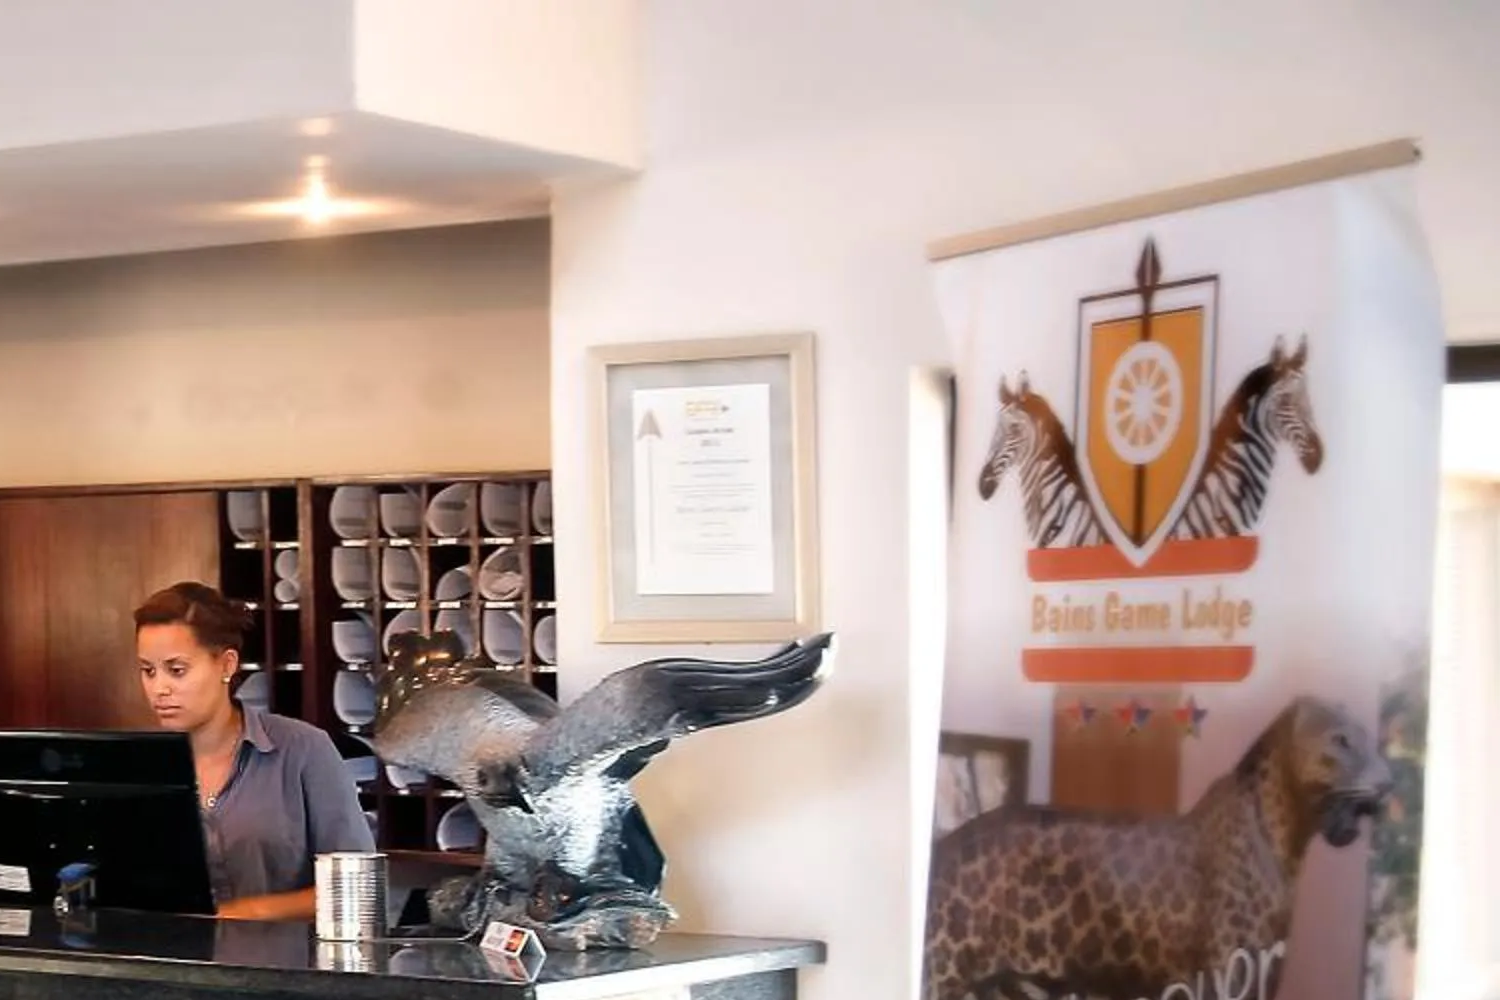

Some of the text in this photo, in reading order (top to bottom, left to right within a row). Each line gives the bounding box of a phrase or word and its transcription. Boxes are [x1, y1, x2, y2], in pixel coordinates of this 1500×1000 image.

[1031, 584, 1253, 641] Bains Game Lodge
